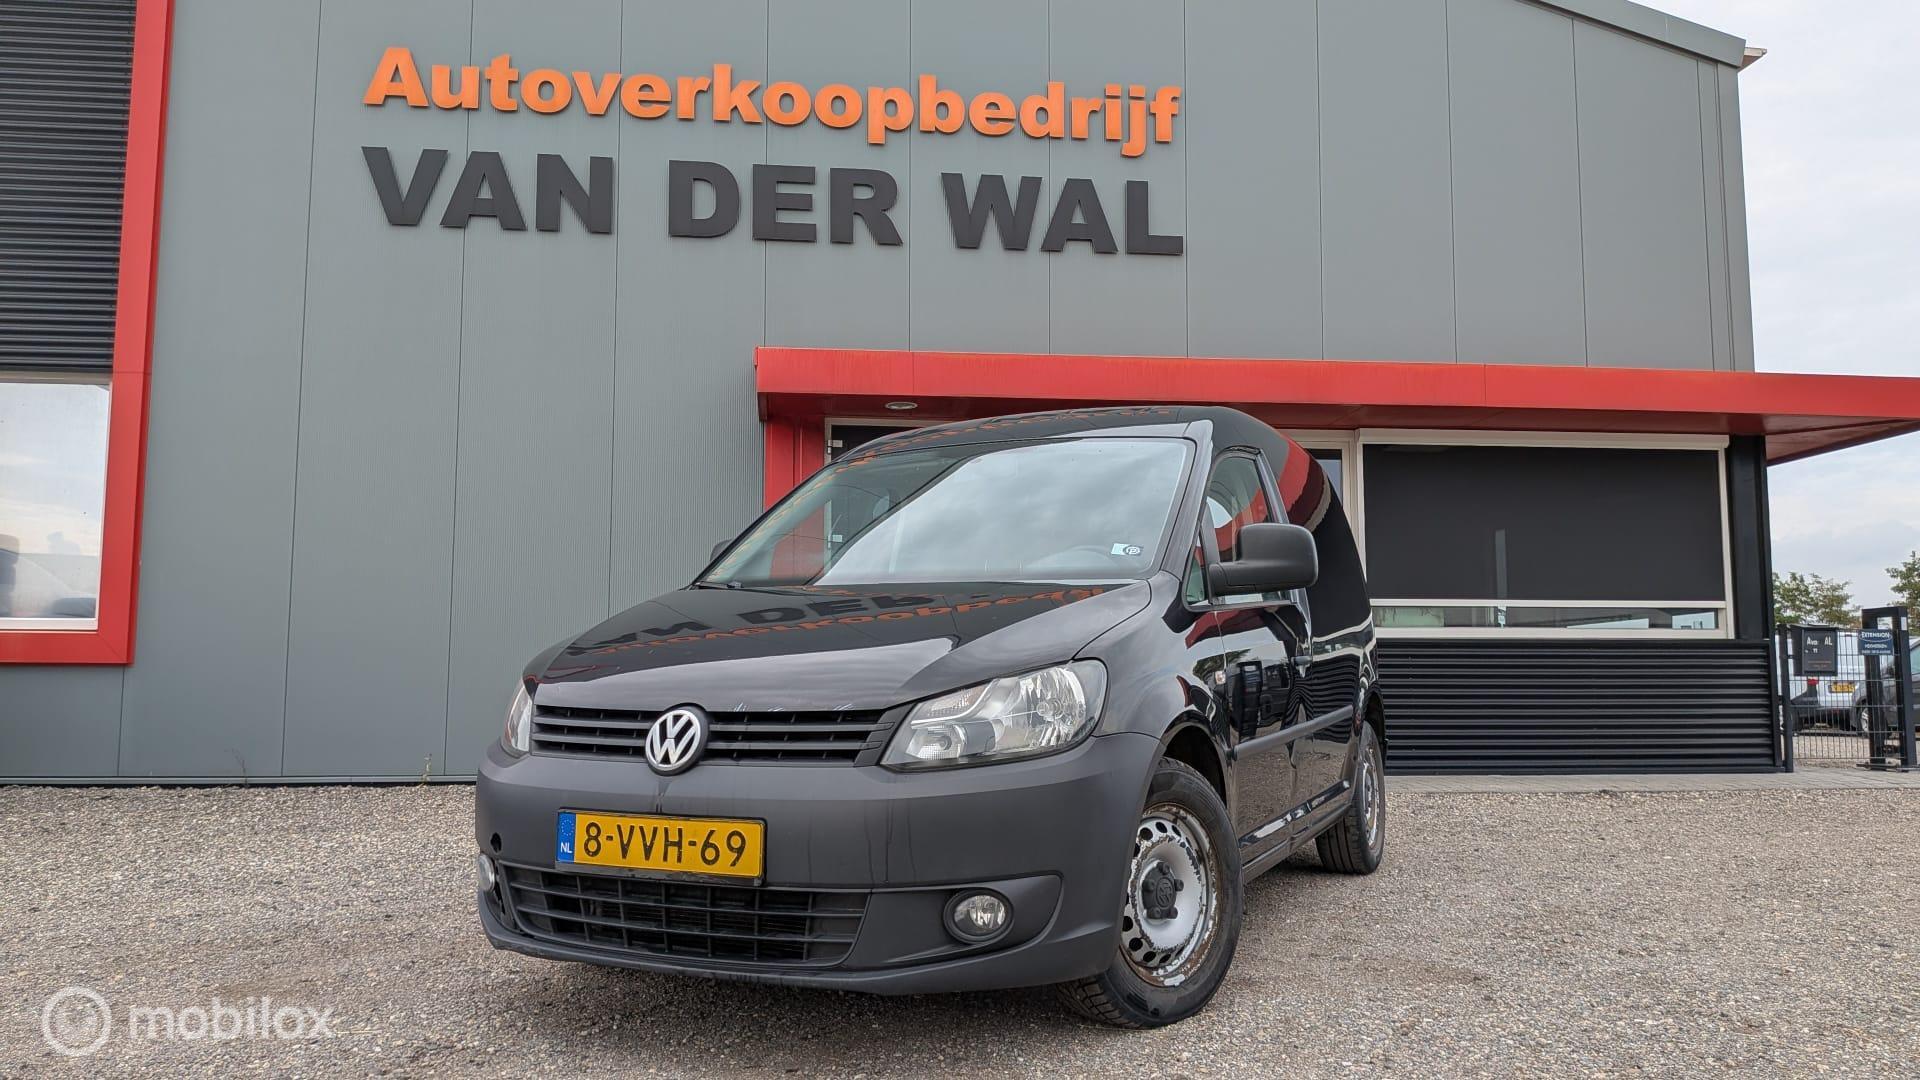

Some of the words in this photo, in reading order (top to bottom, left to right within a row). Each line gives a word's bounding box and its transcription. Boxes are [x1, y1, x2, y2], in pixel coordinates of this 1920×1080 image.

[363, 47, 1181, 157] Autoverkoopbedrijf
[361, 146, 614, 234] VAN
[668, 159, 903, 247] DER
[941, 172, 1184, 256] WAL
[560, 841, 573, 854] NL
[583, 821, 747, 868] 8-VVH-69
